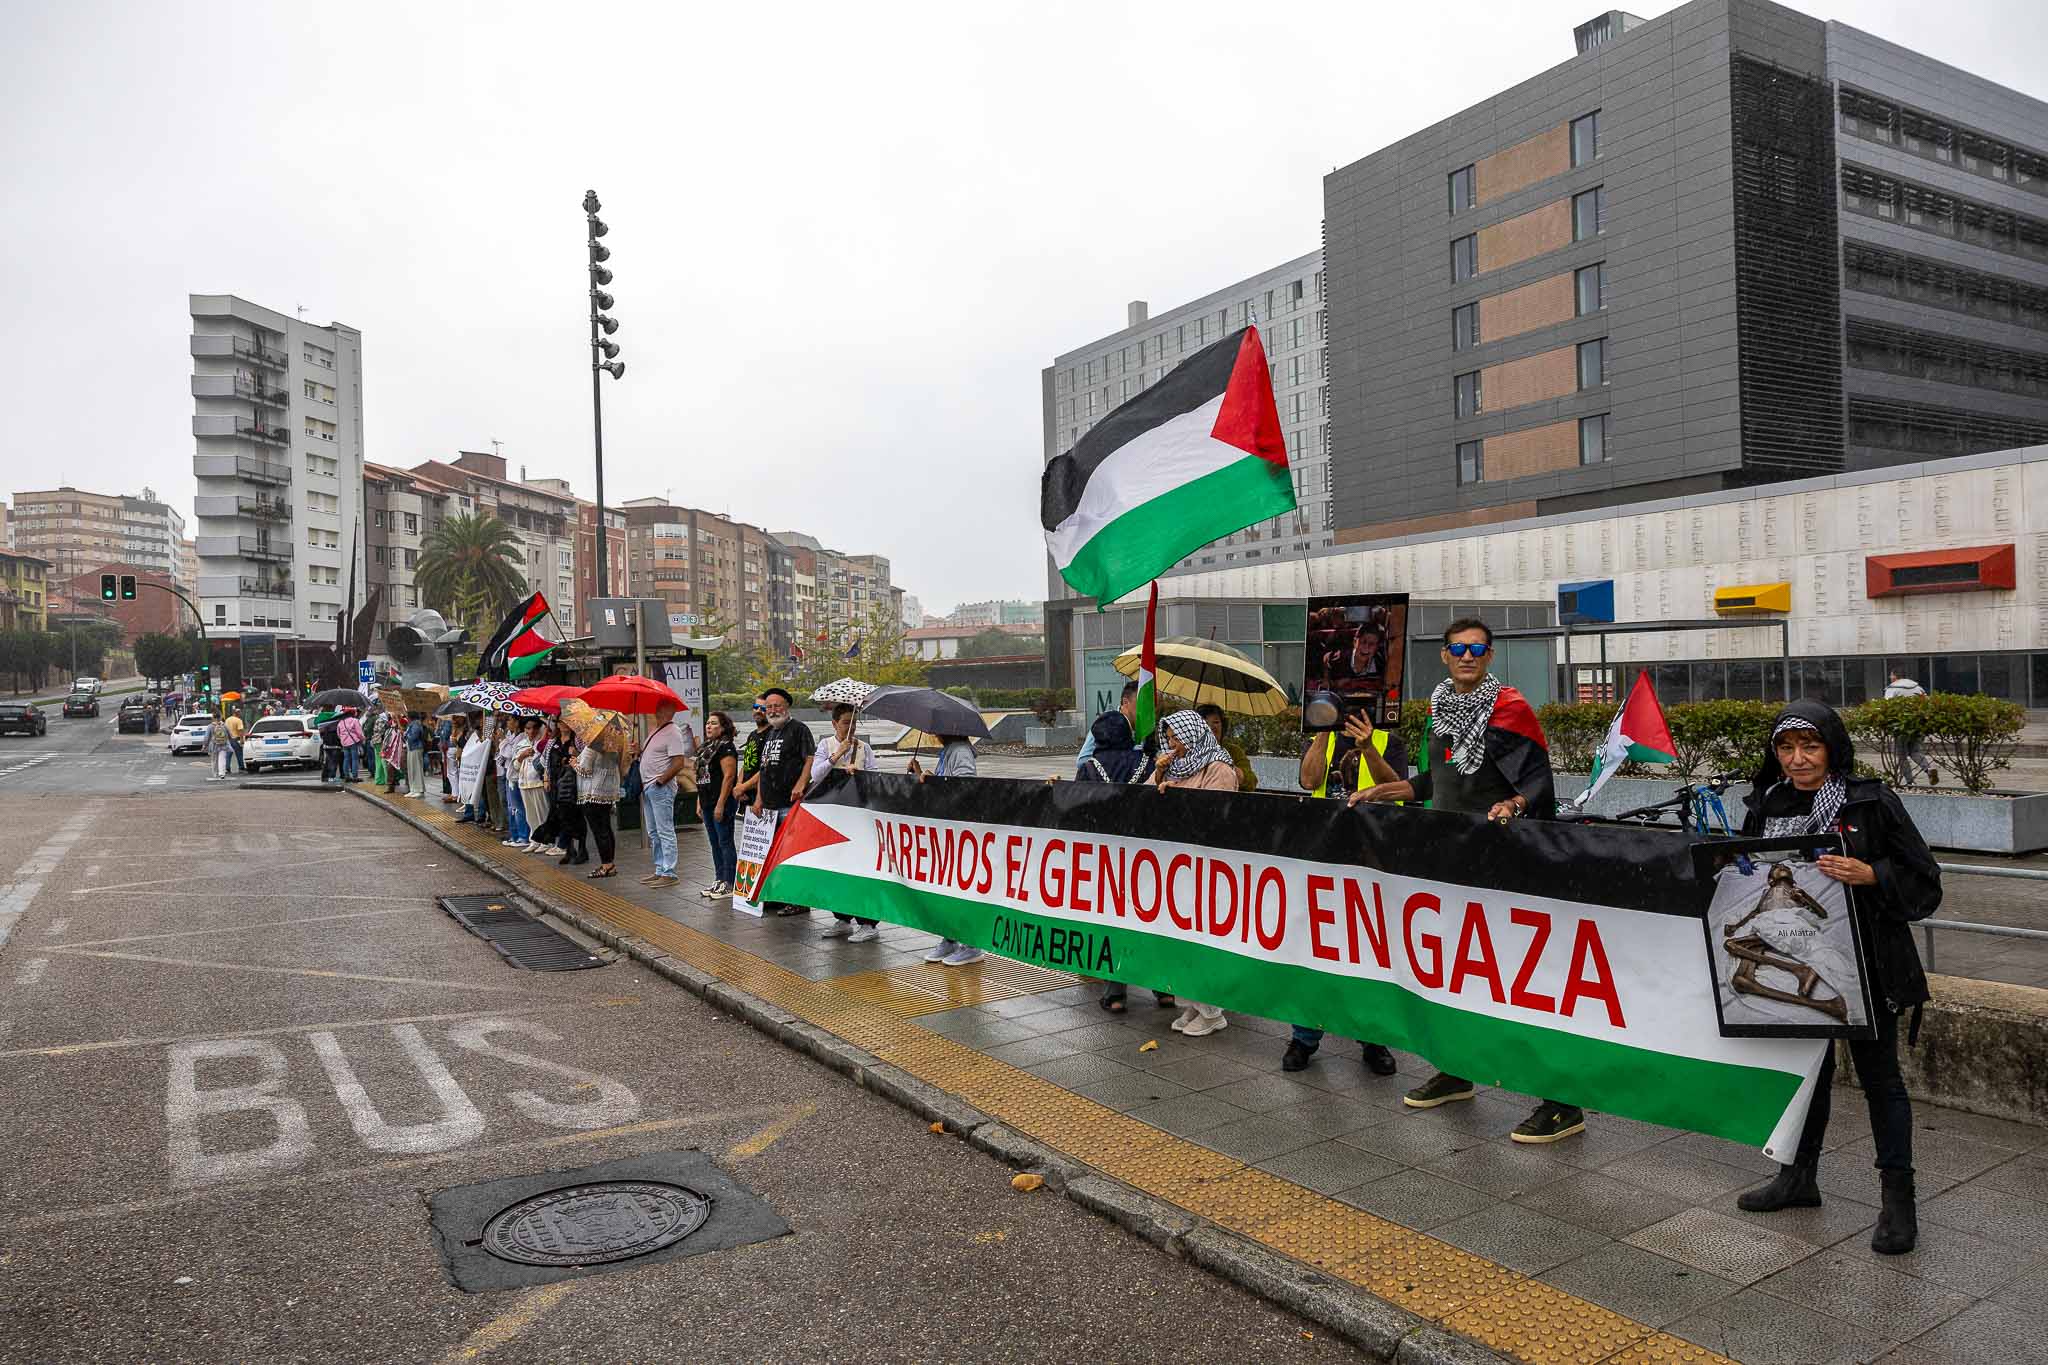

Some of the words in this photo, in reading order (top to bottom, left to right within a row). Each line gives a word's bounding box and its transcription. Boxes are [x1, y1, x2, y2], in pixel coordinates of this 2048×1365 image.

[875, 818, 996, 895] PAREMOS
[1006, 835, 1033, 902] EL
[1039, 838, 1287, 952] GENOCIDIO
[1307, 874, 1392, 970] EN
[1402, 891, 1627, 1029] GAZA
[991, 915, 1114, 974] CANTABRIA
[1778, 929, 1788, 937] Ali
[1789, 929, 1817, 937] Alattar
[166, 1018, 641, 1187] BUS
